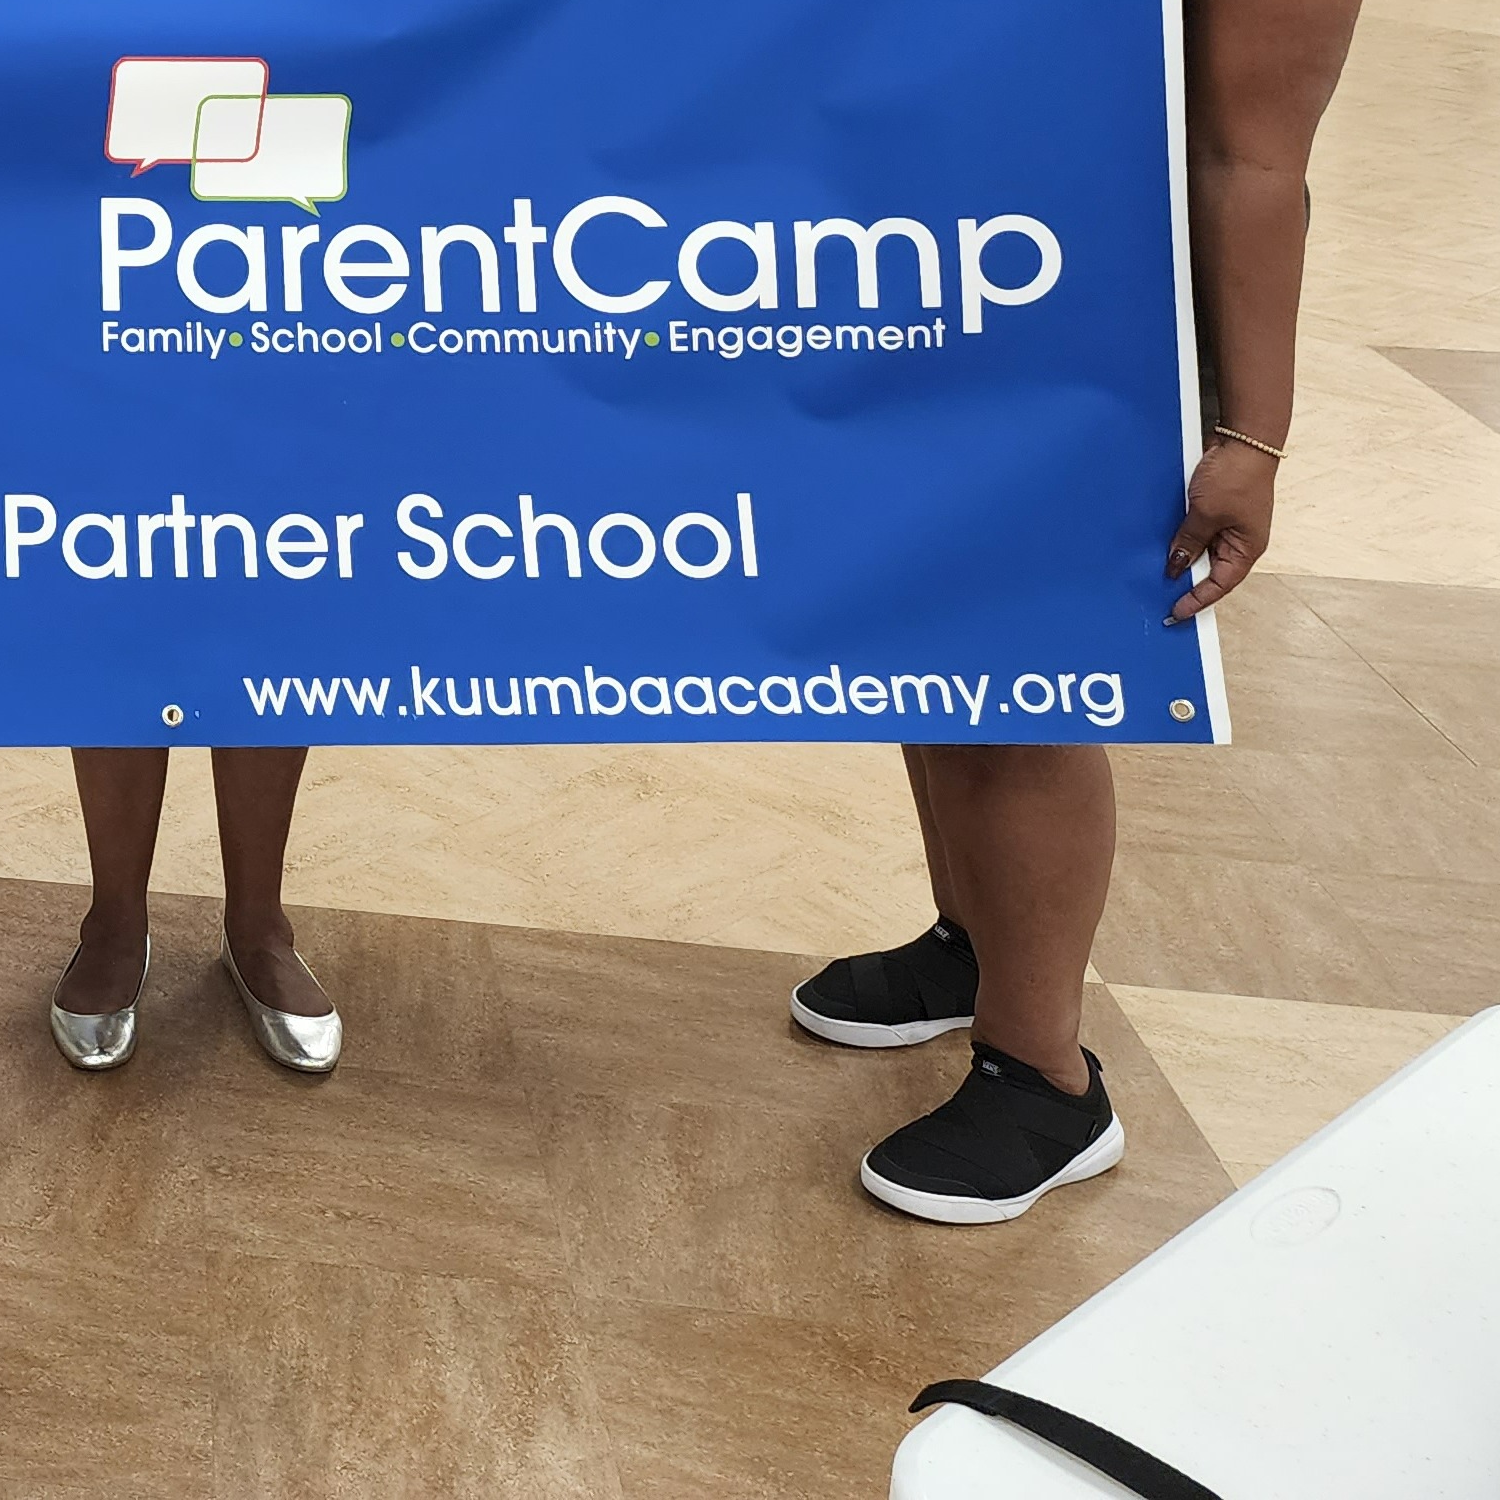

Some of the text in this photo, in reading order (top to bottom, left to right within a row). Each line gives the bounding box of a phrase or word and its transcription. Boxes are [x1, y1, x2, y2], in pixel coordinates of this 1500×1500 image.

[101, 196, 1062, 334] ParentCamp
[103, 321, 226, 360] Family
[251, 321, 381, 354] School
[669, 318, 946, 359] Engagement
[5, 495, 363, 579] Partner
[397, 493, 758, 579] School
[243, 665, 1124, 727] www.kuumbaacademy.org
